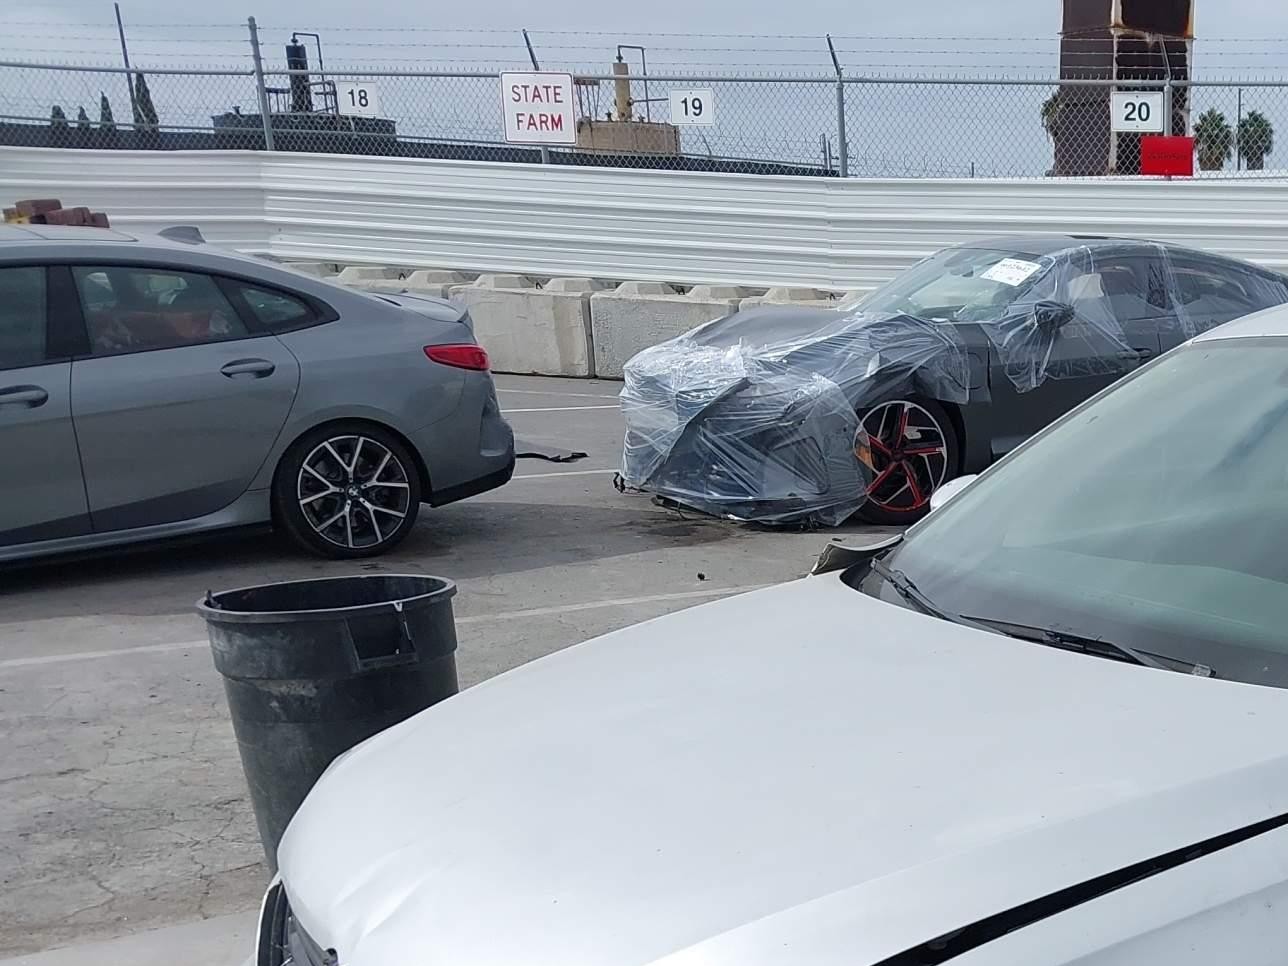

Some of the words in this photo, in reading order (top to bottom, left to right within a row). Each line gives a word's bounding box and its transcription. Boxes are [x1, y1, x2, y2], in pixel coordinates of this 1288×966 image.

[347, 88, 369, 108] 18
[511, 84, 564, 104] STATE
[680, 97, 703, 117] 19
[1123, 101, 1151, 122] 20
[515, 112, 563, 132] FARM
